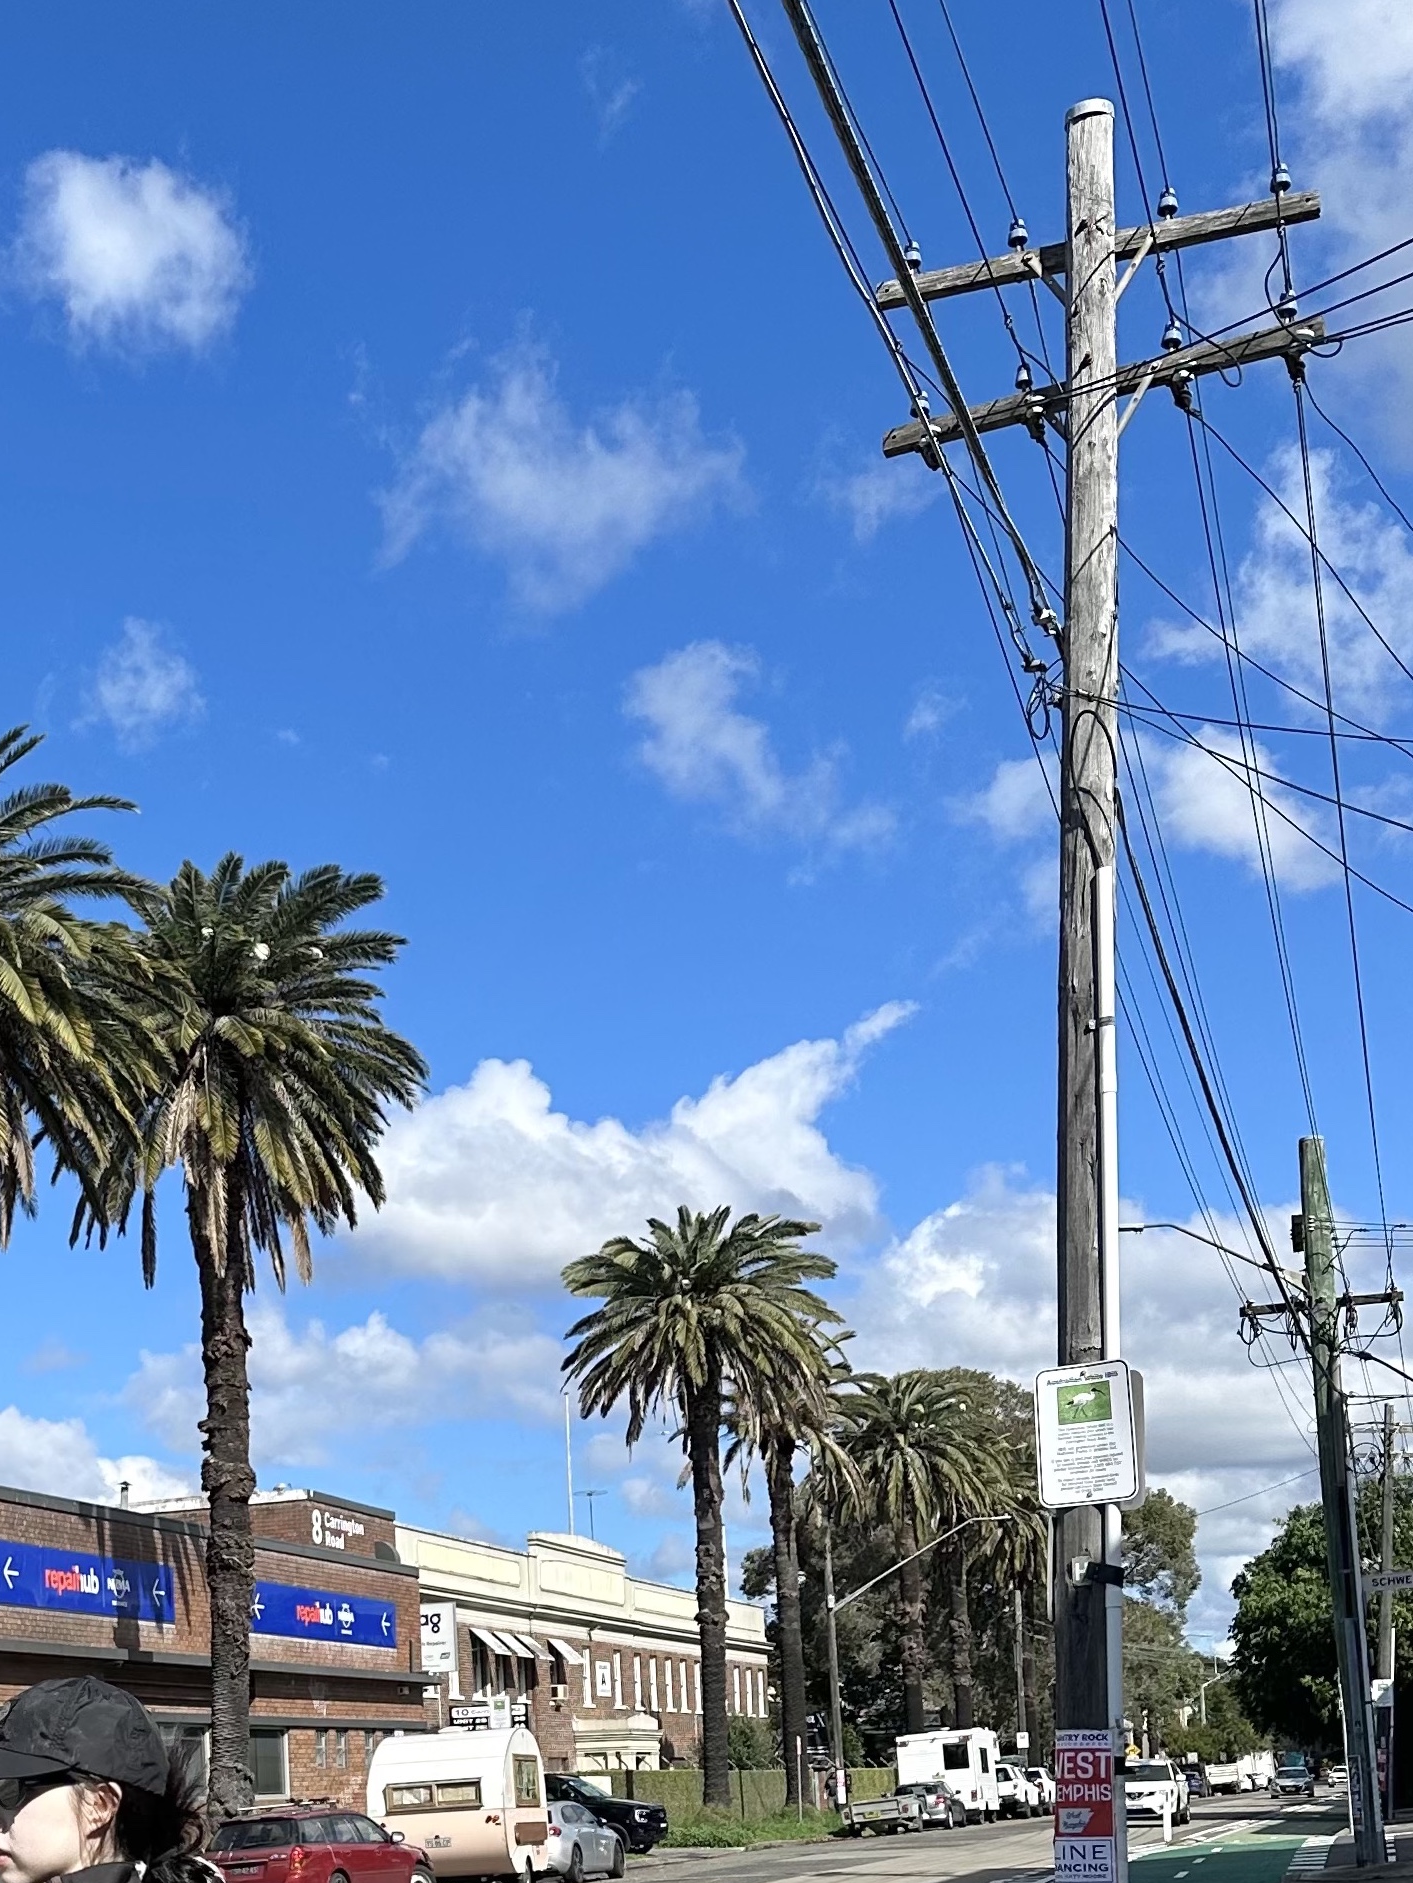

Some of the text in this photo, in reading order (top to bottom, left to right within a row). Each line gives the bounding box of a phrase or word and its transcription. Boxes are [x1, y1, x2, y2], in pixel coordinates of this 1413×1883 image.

[311, 1509, 323, 1544] 8
[324, 1512, 365, 1537] Carrington
[325, 1530, 345, 1550] Road
[1371, 1575, 1413, 1587] SCHWE
[1081, 1733, 1108, 1742] ROCK
